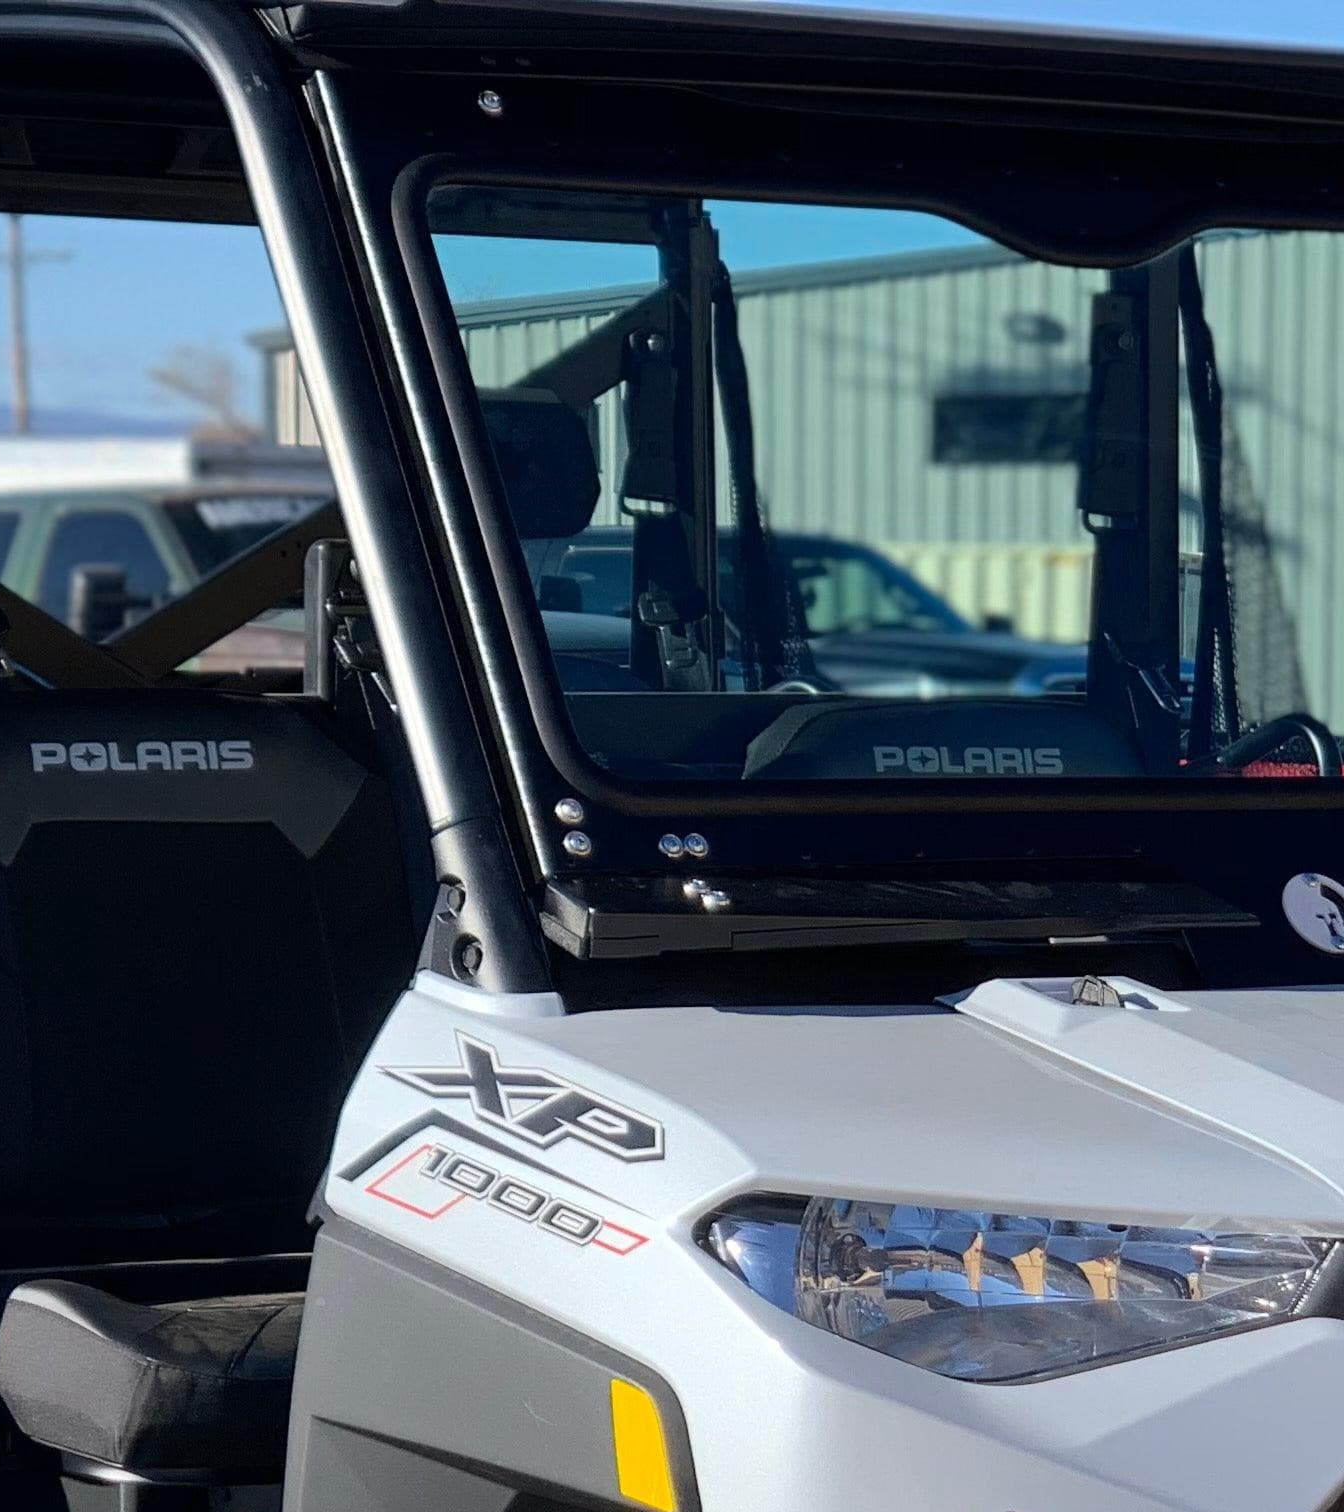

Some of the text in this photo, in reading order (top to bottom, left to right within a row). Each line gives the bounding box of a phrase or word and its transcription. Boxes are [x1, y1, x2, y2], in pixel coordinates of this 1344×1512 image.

[30, 740, 254, 772] POLARIS
[873, 746, 1064, 774] POLARIS
[375, 1028, 665, 1164] XP
[418, 1143, 605, 1247] 1000
